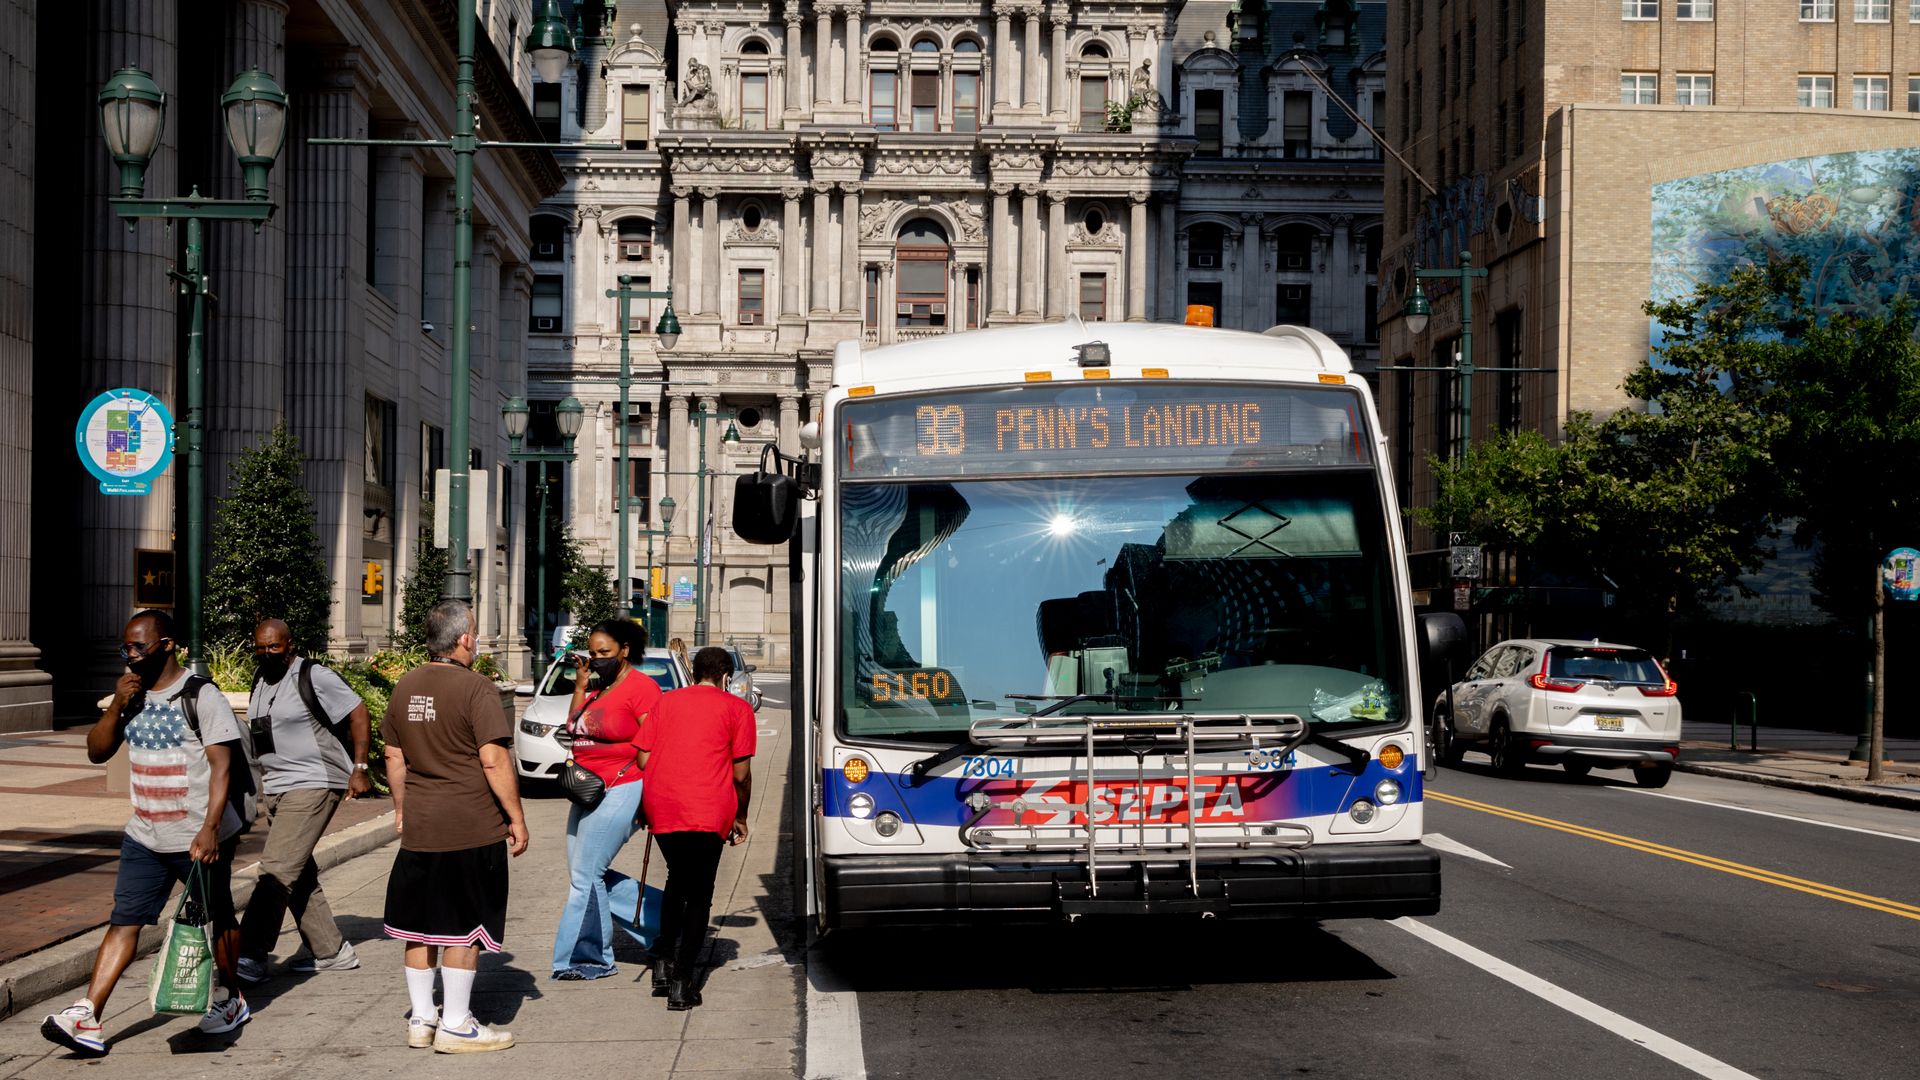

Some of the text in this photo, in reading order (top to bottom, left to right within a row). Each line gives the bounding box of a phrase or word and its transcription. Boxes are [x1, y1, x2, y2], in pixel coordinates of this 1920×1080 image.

[916, 403, 1261, 455] 33 PENN'S LANDING
[873, 671, 950, 701] 5160
[961, 757, 1015, 778] 7304
[1083, 783, 1244, 822] SEPTA
[177, 956, 202, 968] BAG
[180, 945, 205, 957] ONE
